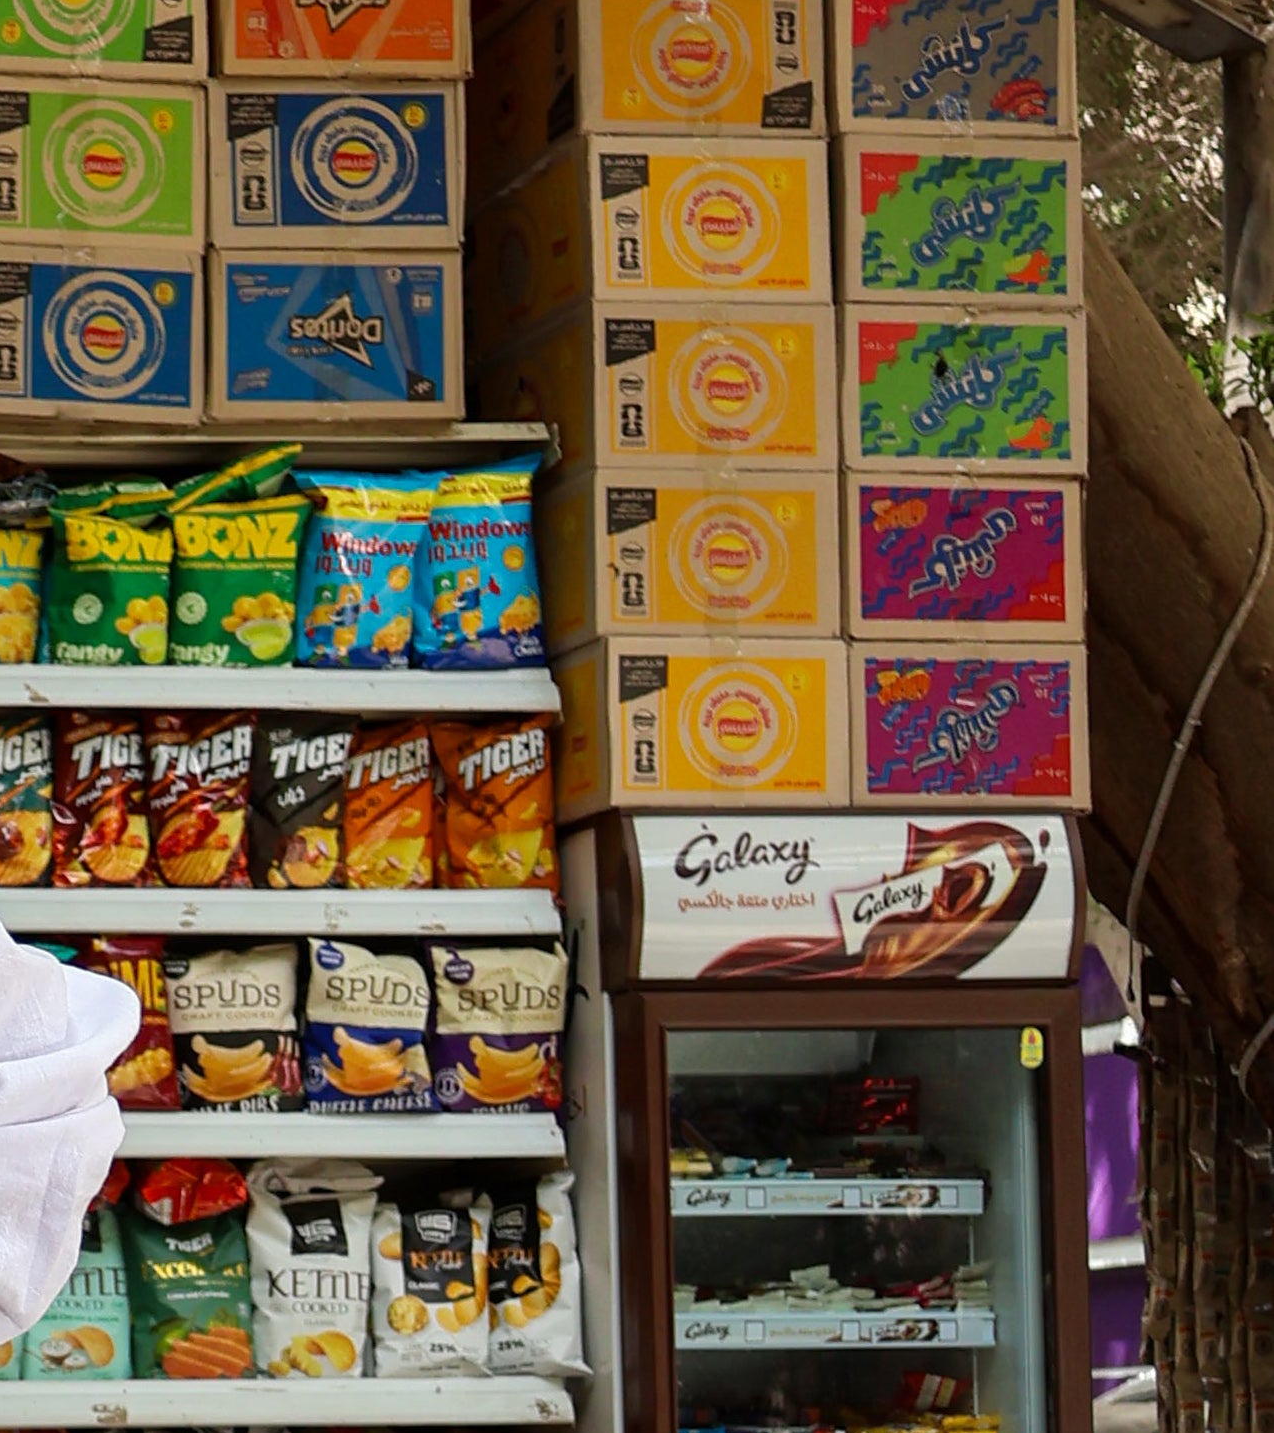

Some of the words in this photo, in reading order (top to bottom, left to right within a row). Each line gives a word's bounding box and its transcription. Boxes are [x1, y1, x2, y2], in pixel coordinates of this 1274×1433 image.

[290, 314, 384, 344] Doritos
[173, 513, 300, 561] BONZ
[428, 519, 532, 542] Windows
[347, 737, 431, 790] TIGER
[458, 727, 546, 792] TIGER
[674, 824, 820, 887] Galaxy
[852, 882, 927, 925] Galaxy
[173, 981, 282, 1011] SPUDS
[458, 985, 561, 1013] SPUDS
[267, 1269, 369, 1300] KETTLE
